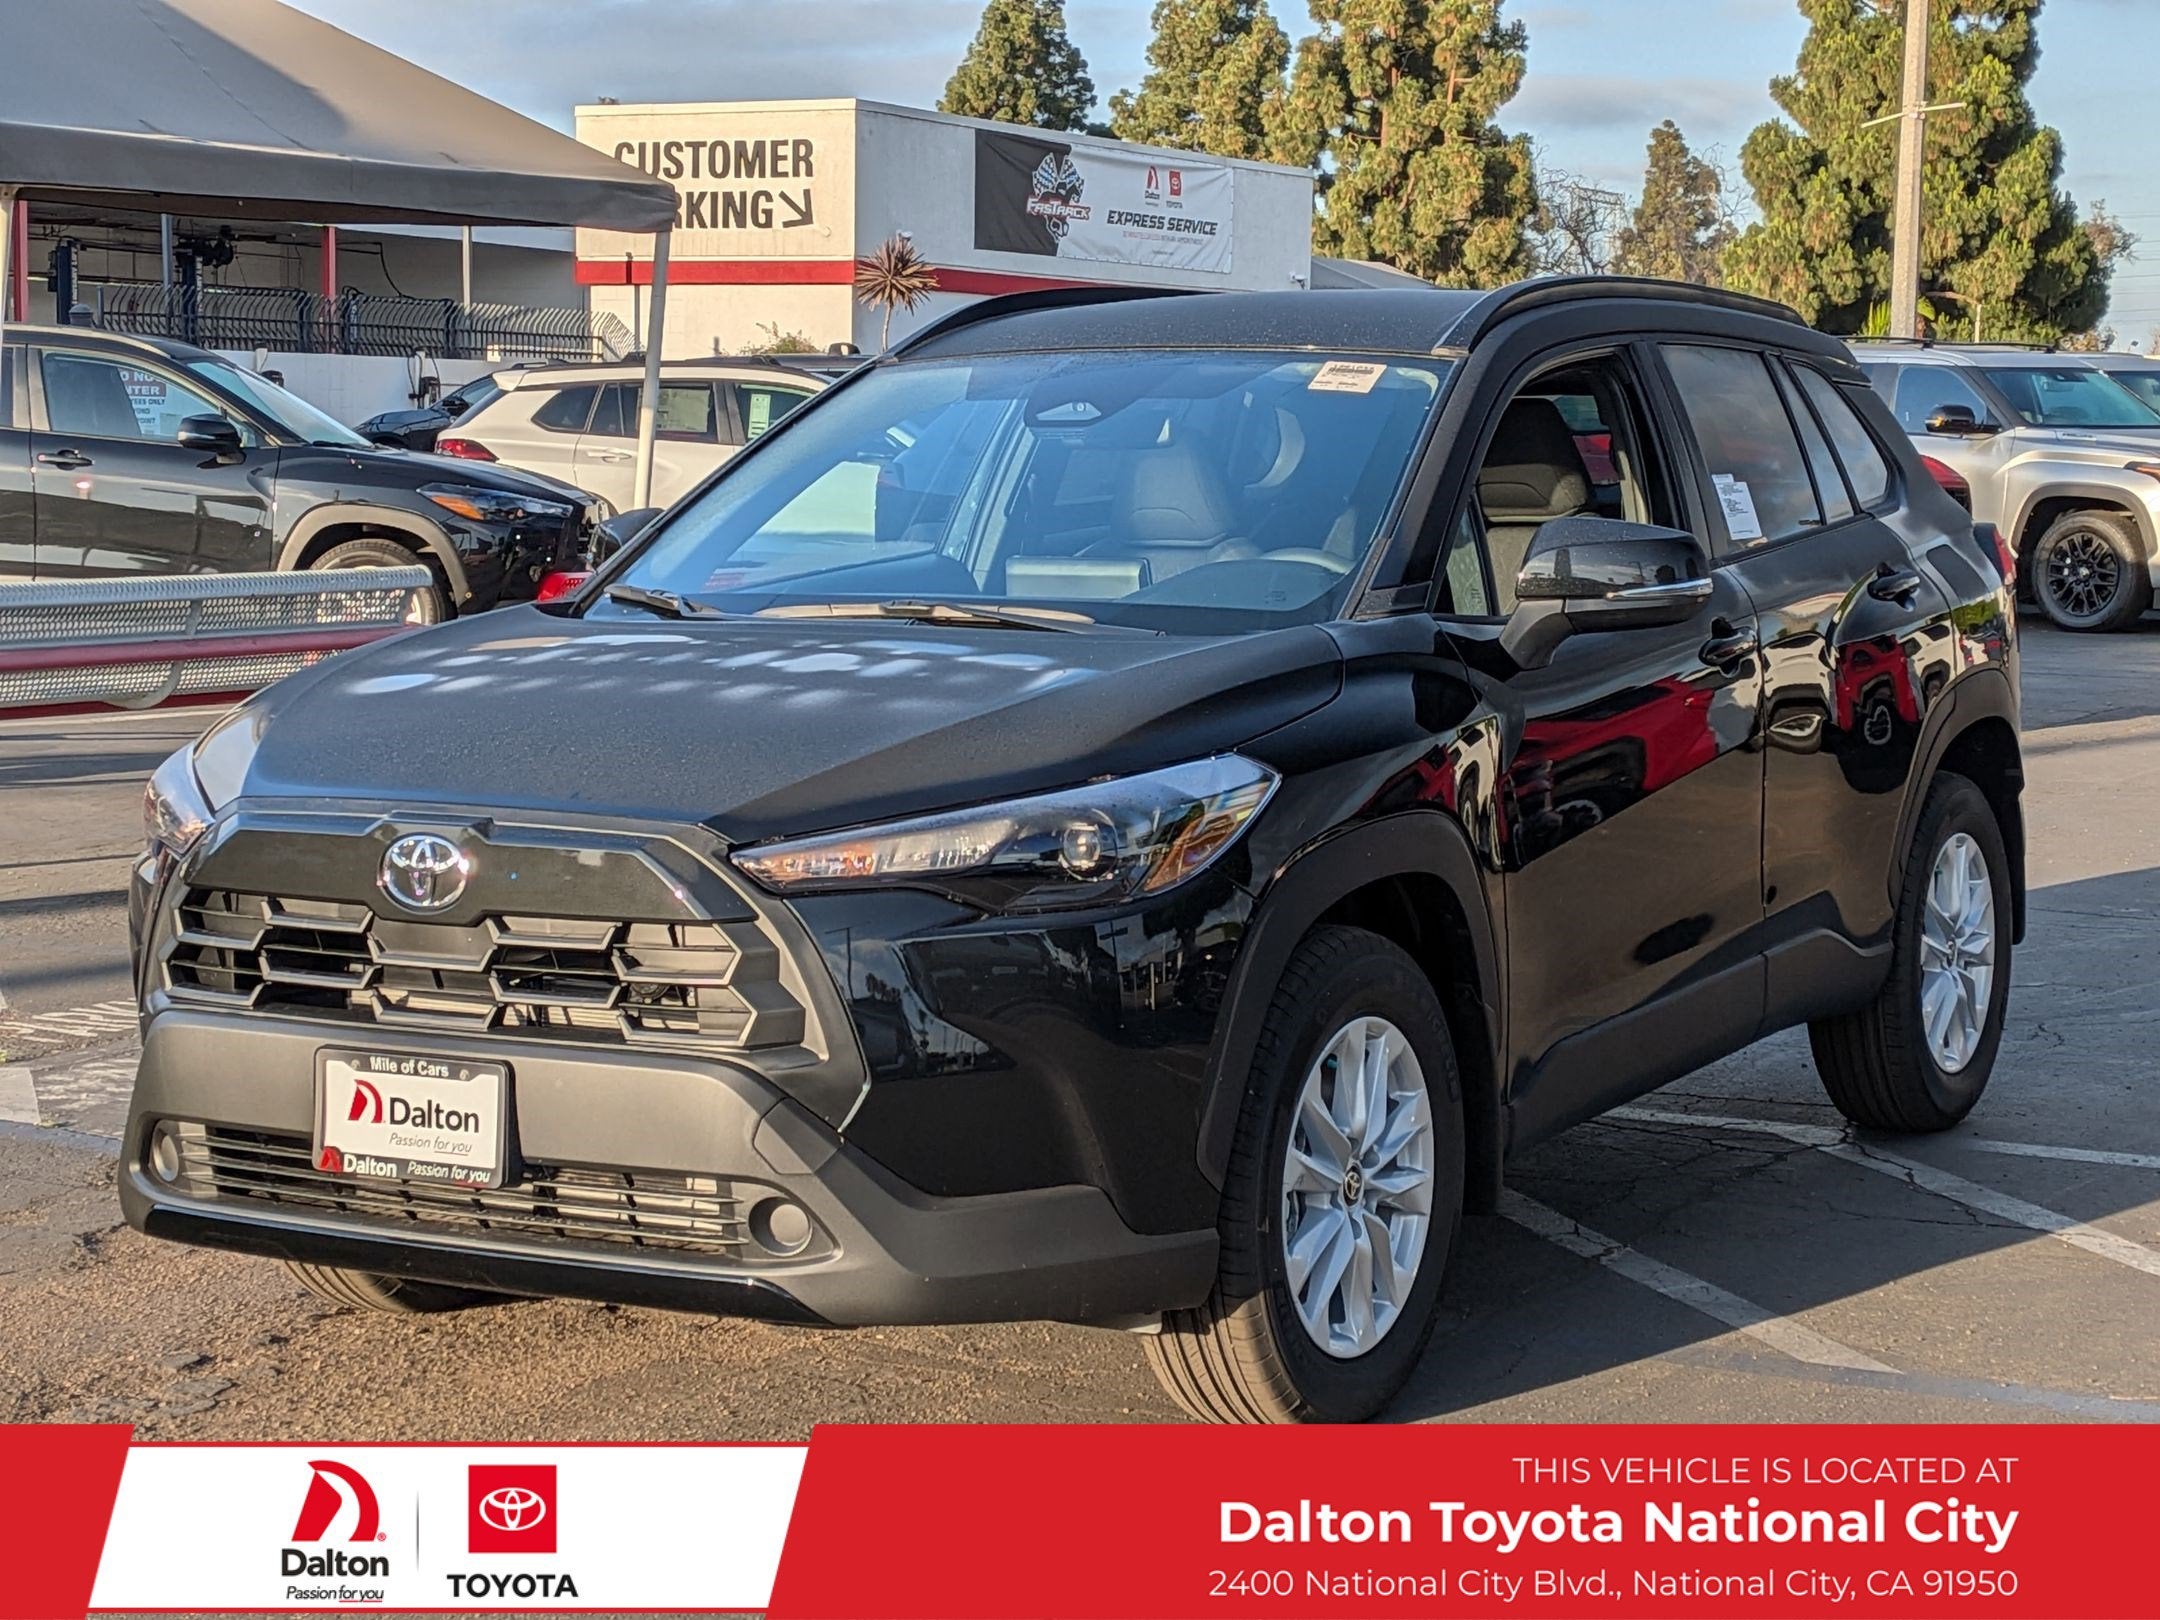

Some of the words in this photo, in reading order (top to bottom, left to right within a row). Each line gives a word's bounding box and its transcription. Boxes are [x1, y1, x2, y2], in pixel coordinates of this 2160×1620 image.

[1107, 209, 1166, 231] EXPRESS
[1166, 216, 1218, 236] SERVICE
[126, 385, 161, 395] NTER
[369, 1056, 398, 1073] Mile
[400, 1059, 415, 1074] of
[417, 1060, 449, 1078] Cars
[389, 1096, 480, 1134] Dalton
[389, 1132, 431, 1149] Passion
[433, 1135, 450, 1151] for
[451, 1142, 473, 1154] you
[343, 1153, 398, 1178] Dalton
[407, 1161, 449, 1179] Passion
[450, 1165, 468, 1179] for
[467, 1169, 491, 1184] you
